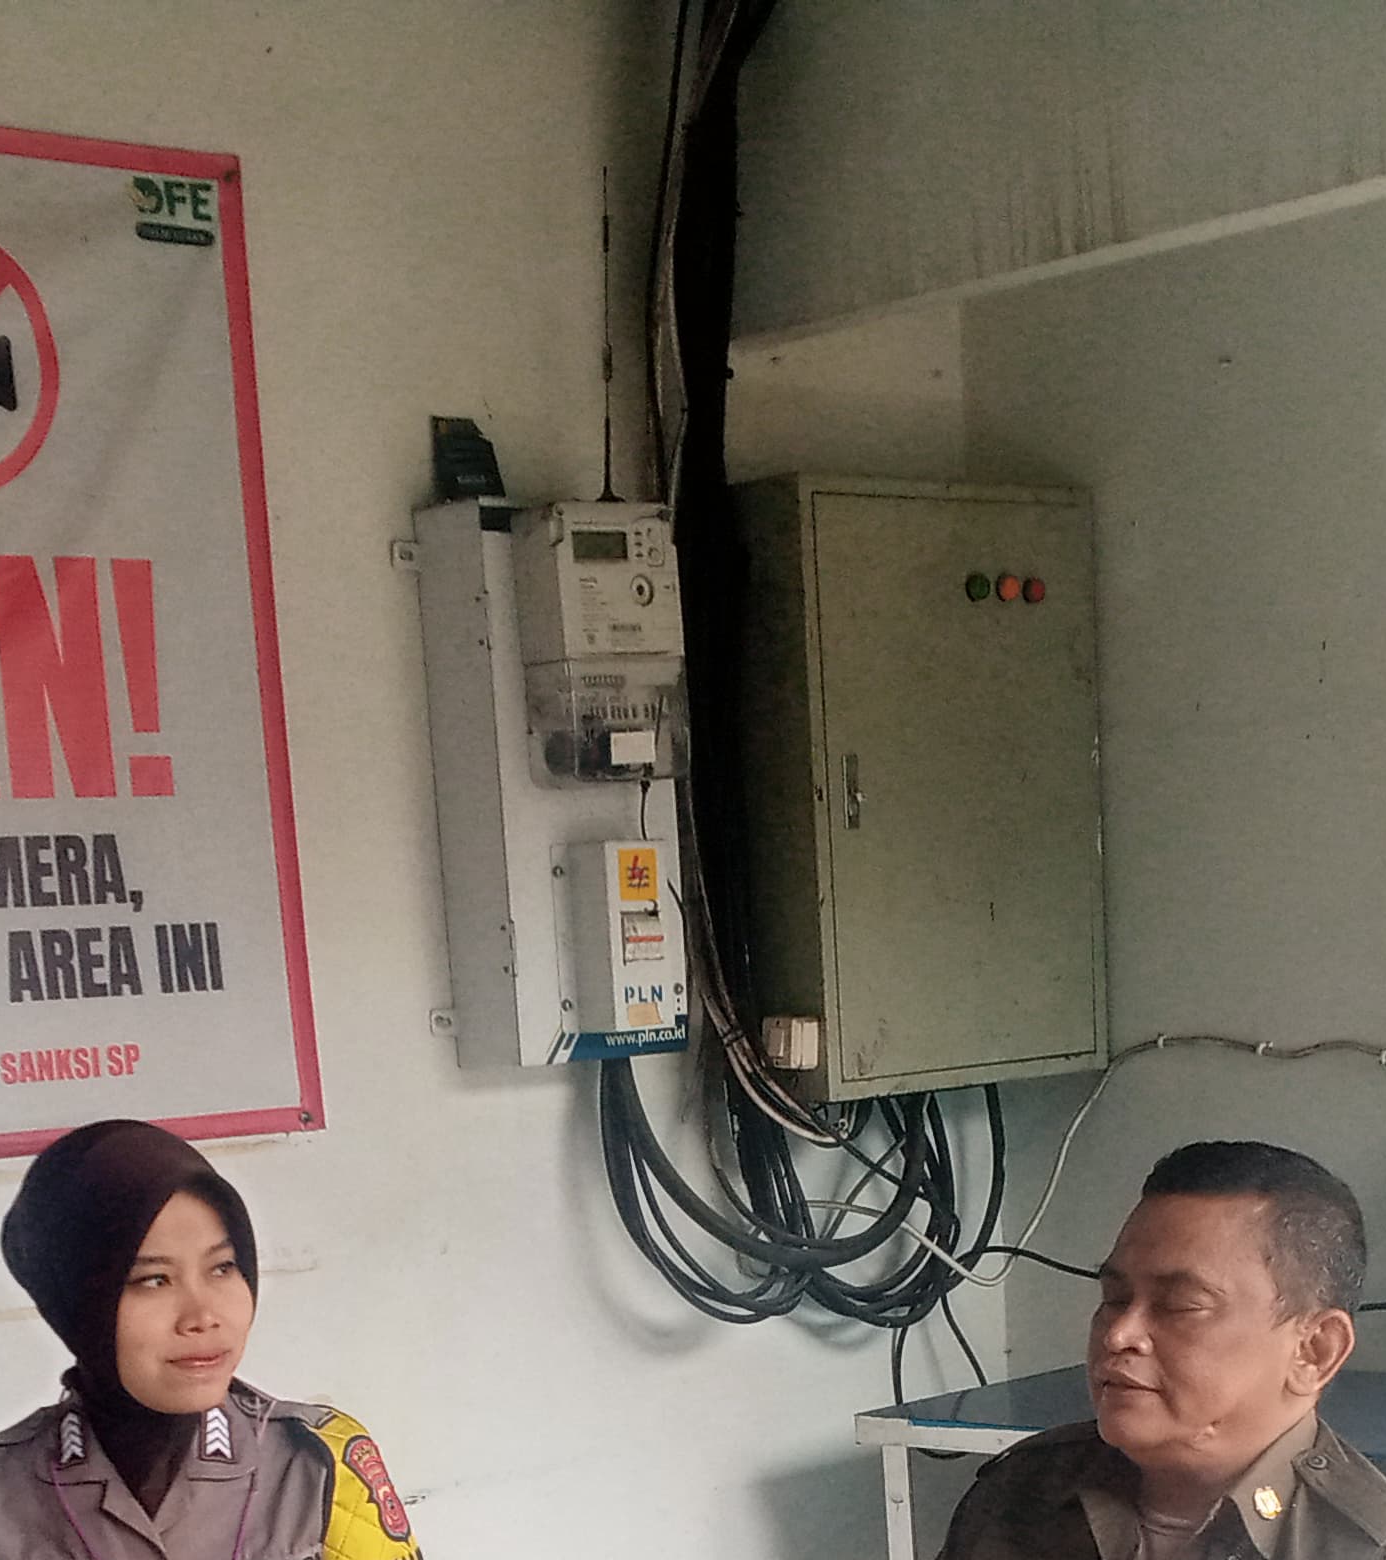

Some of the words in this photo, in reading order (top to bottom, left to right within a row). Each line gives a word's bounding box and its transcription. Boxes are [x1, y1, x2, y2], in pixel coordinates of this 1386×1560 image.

[7, 926, 143, 1004] AREA
[154, 921, 225, 993] INI
[624, 984, 663, 1004] PLN
[605, 1024, 687, 1047] www.pln.co.id
[0, 1045, 101, 1085] SANKSI
[105, 1042, 141, 1076] SP
